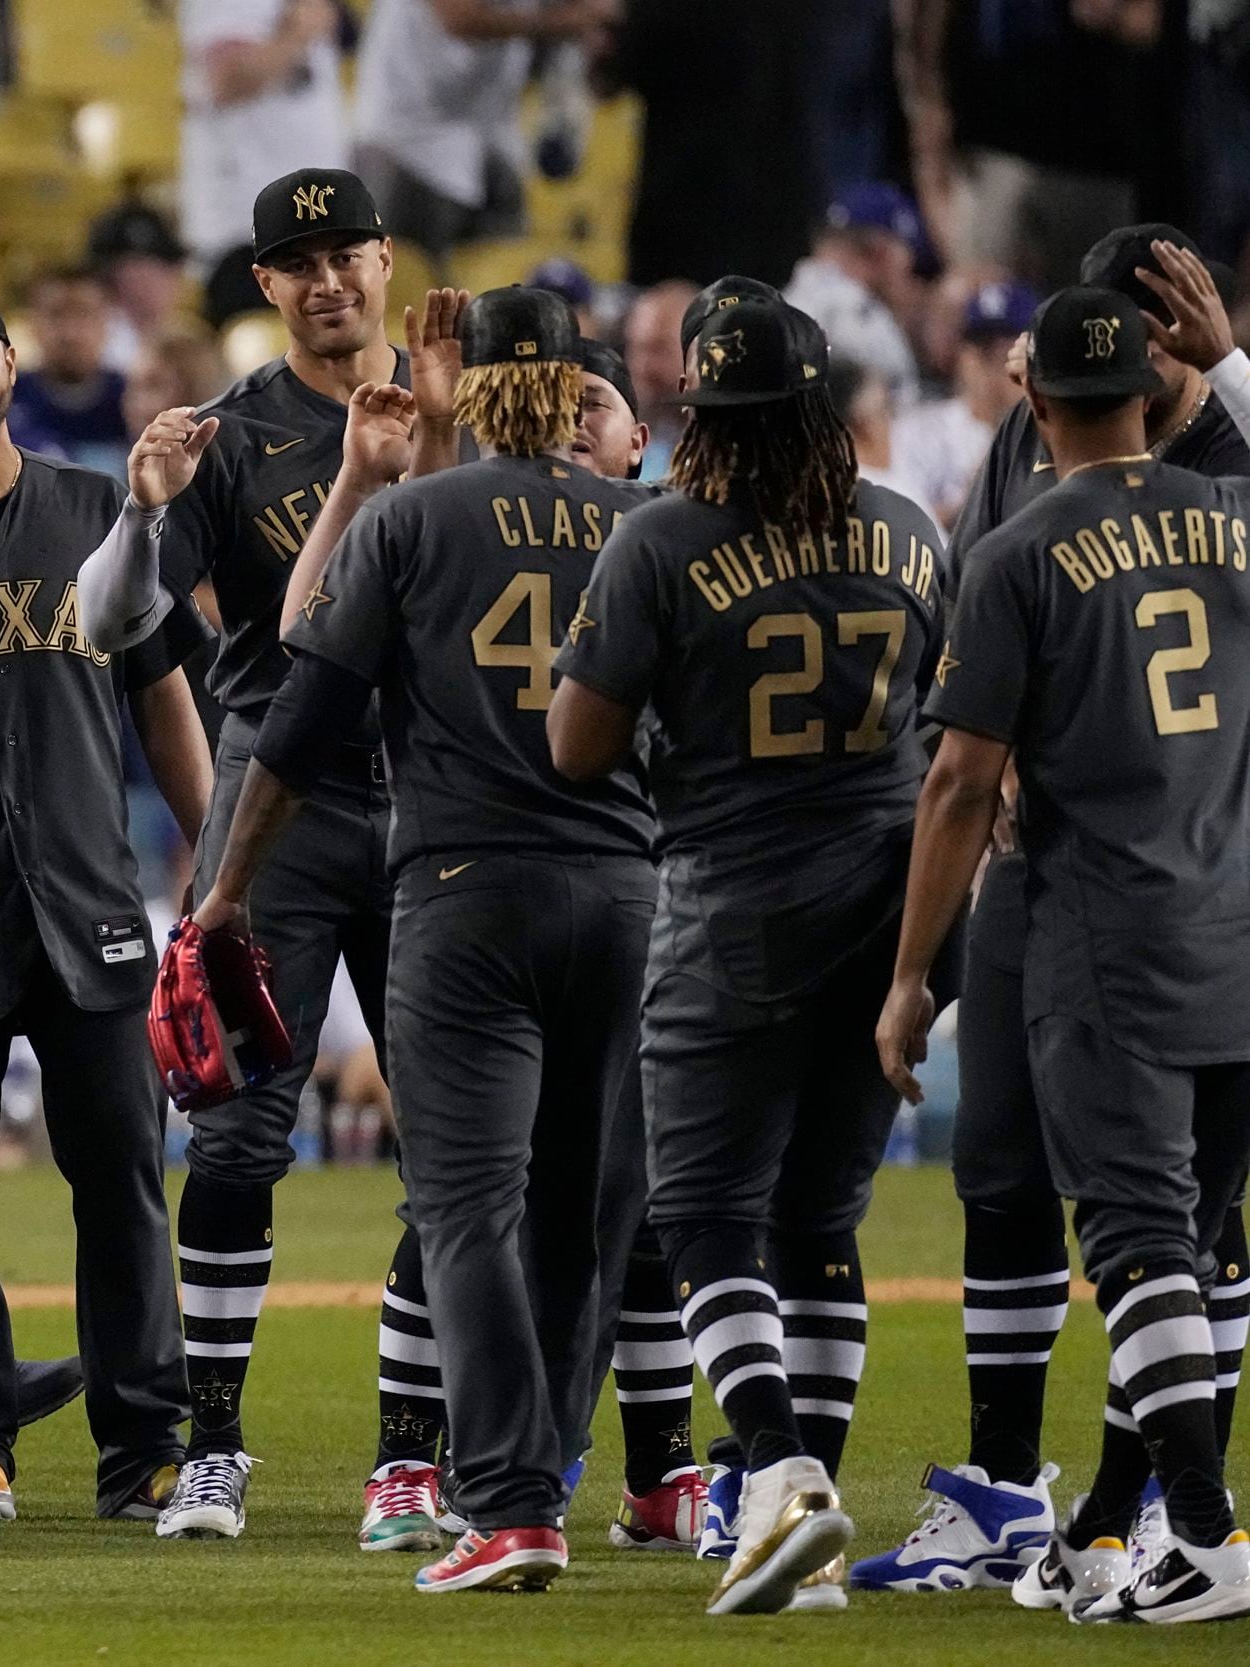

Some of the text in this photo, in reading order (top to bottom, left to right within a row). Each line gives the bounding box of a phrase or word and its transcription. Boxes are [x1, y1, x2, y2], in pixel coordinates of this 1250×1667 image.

[688, 517, 891, 612] GUERRERO
[1051, 508, 1247, 594] BOGAERTS
[747, 609, 906, 759] 27
[1135, 588, 1219, 736] 2
